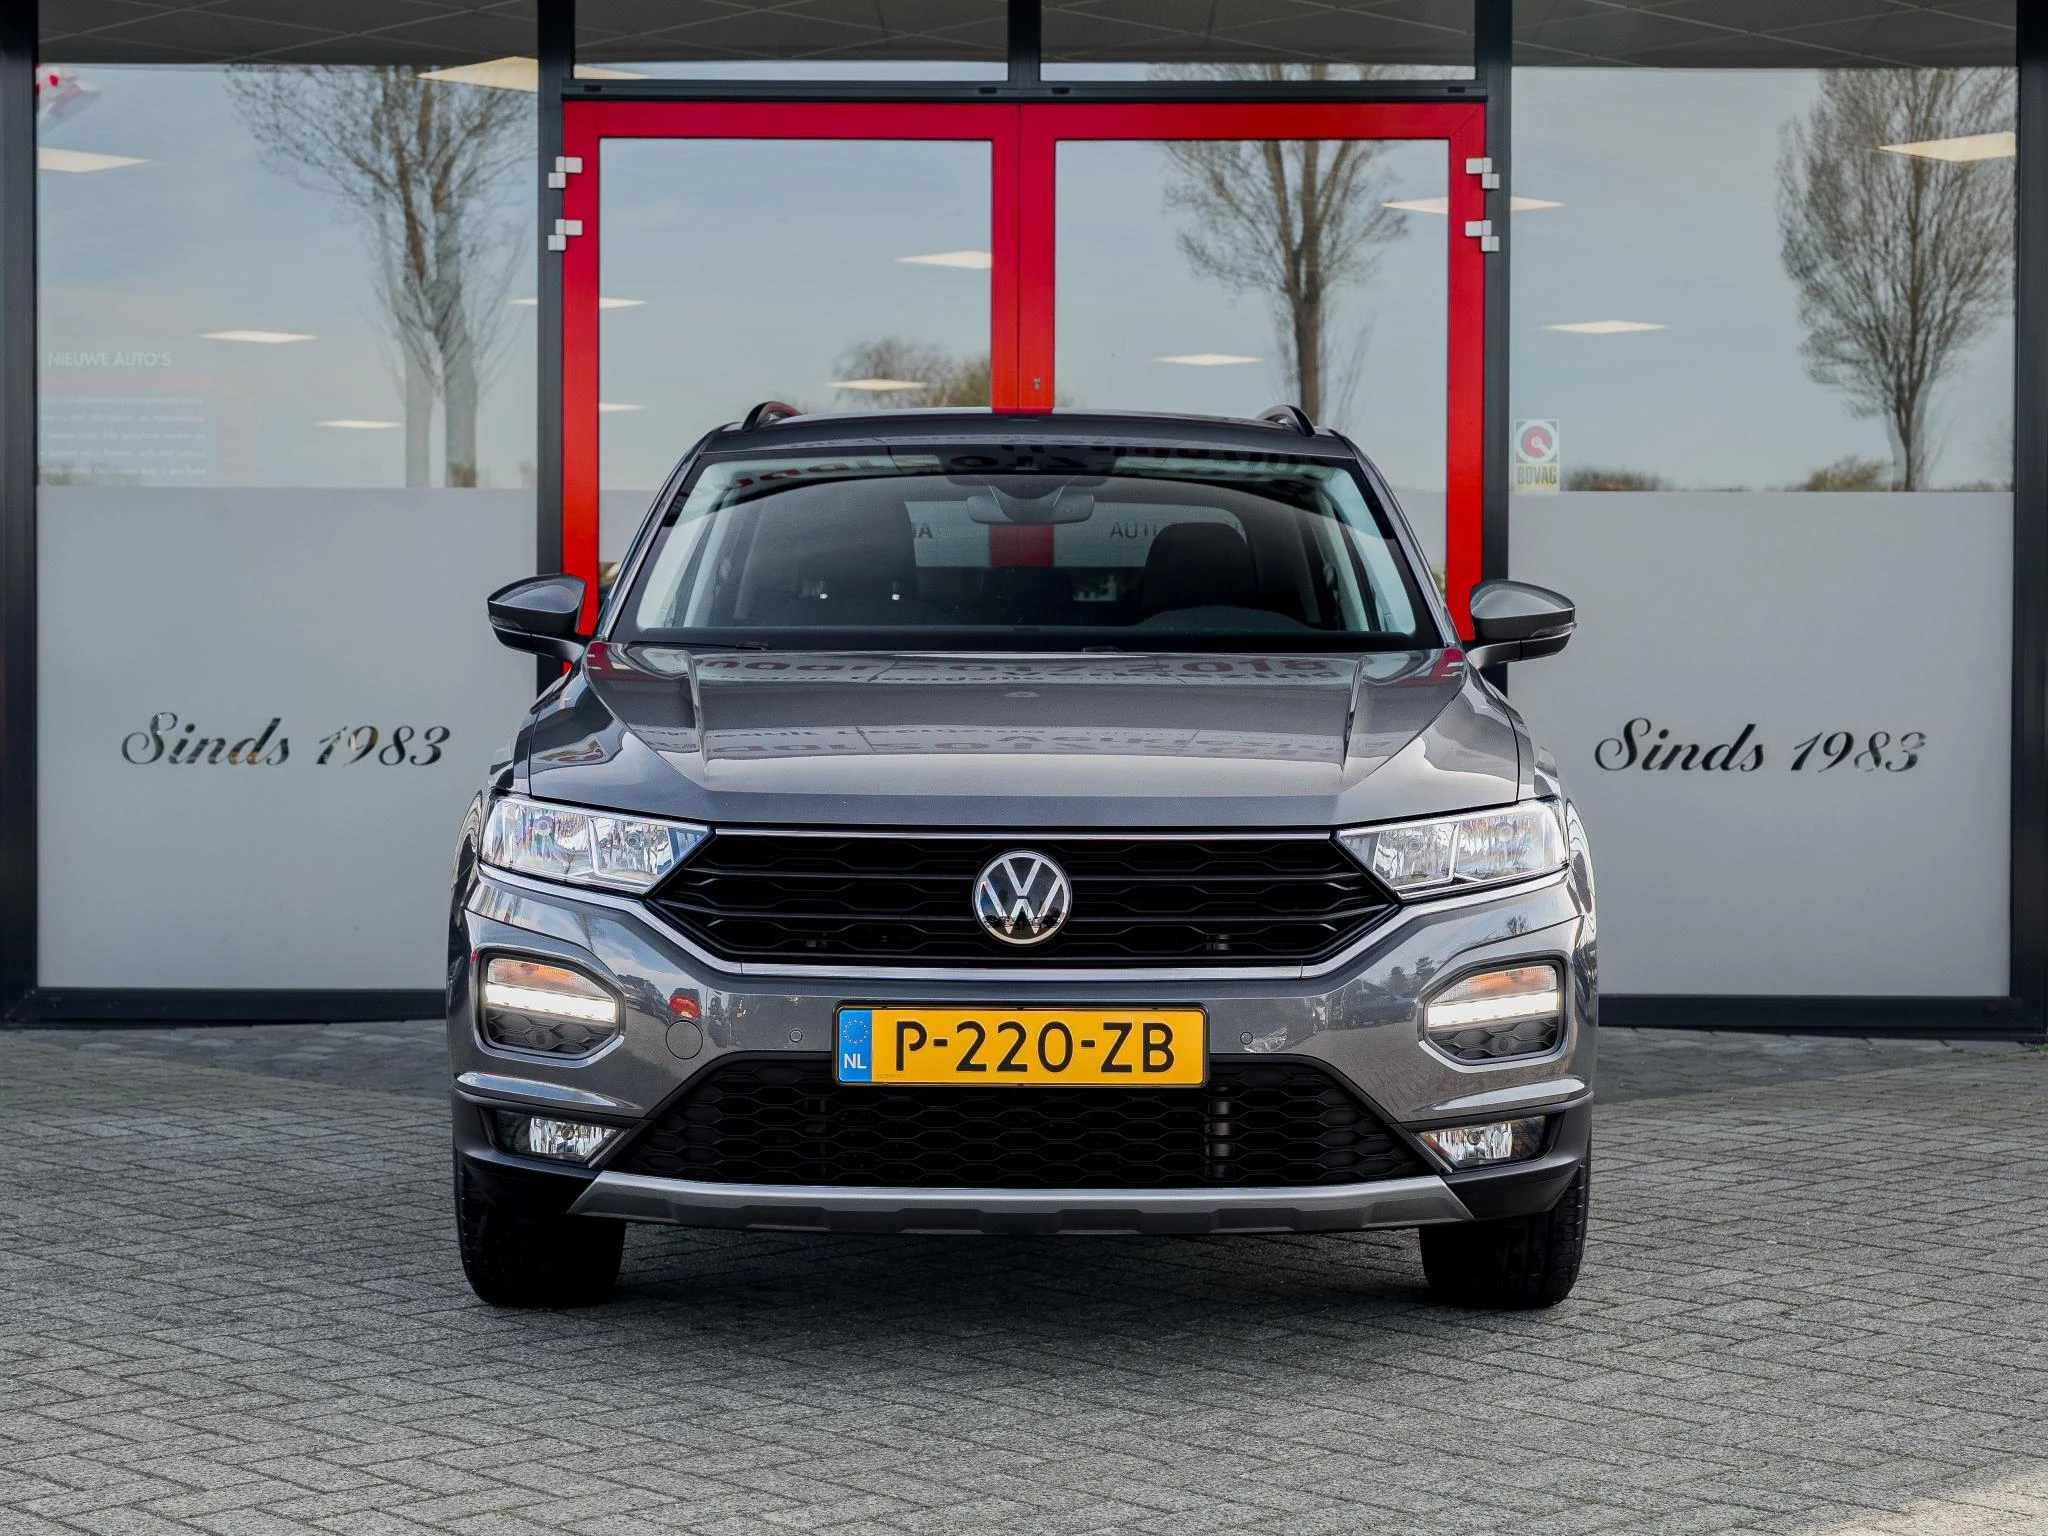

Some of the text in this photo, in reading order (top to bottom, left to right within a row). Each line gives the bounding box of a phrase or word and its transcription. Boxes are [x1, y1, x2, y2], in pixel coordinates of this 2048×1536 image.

[48, 351, 172, 367] NIEUWE AUTO'S
[1517, 466, 1557, 485] BOVAG
[121, 711, 451, 767] Sinds 1983
[1594, 717, 1927, 773] Sinds 1983
[979, 855, 1066, 936] VW
[843, 1053, 868, 1069] NL
[895, 1020, 1176, 1073] P-220-ZB
